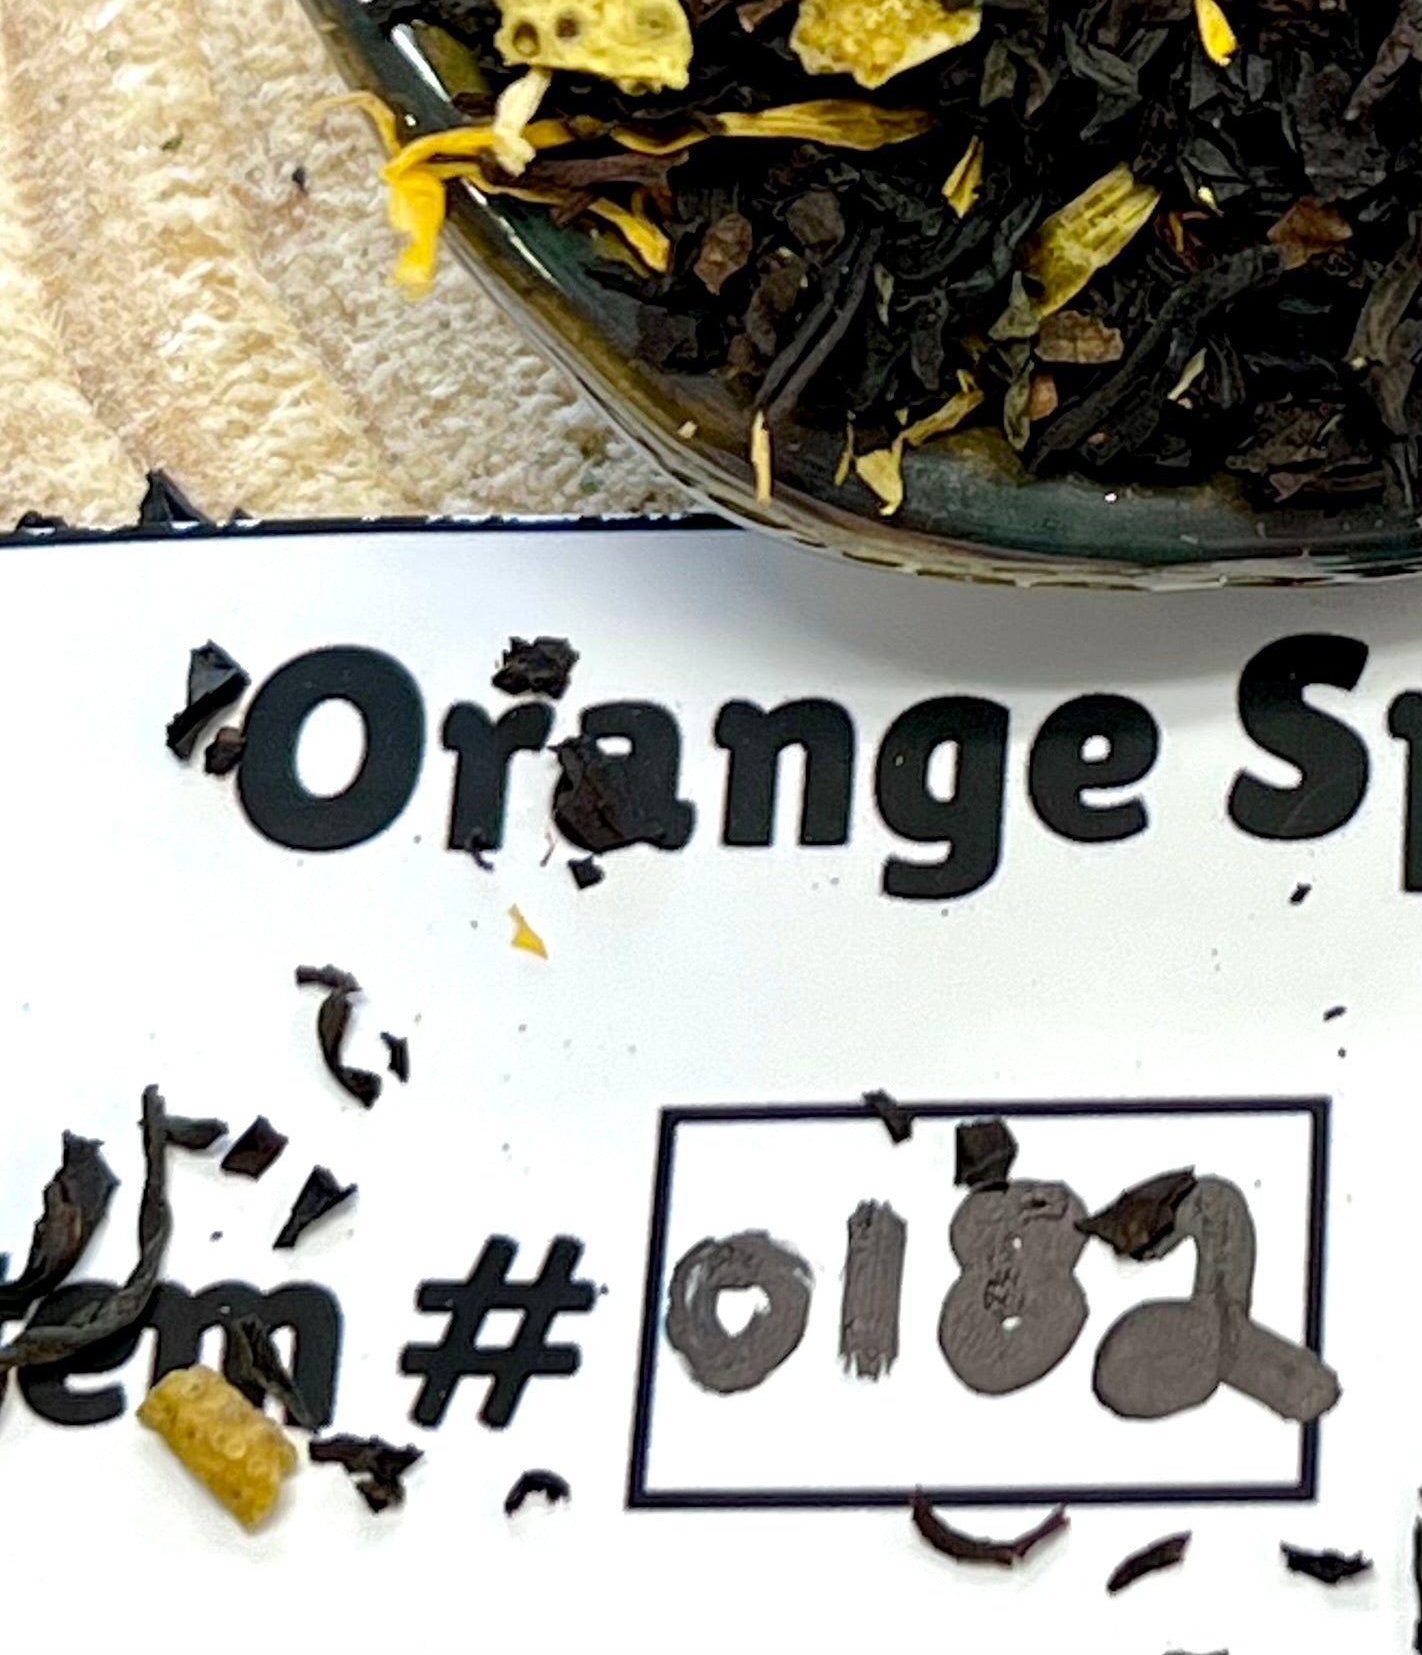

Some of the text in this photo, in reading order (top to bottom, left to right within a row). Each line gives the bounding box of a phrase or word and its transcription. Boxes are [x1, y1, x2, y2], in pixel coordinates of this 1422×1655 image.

[236, 645, 1161, 900] Orange
[0, 1173, 1342, 1431] em # 0182
